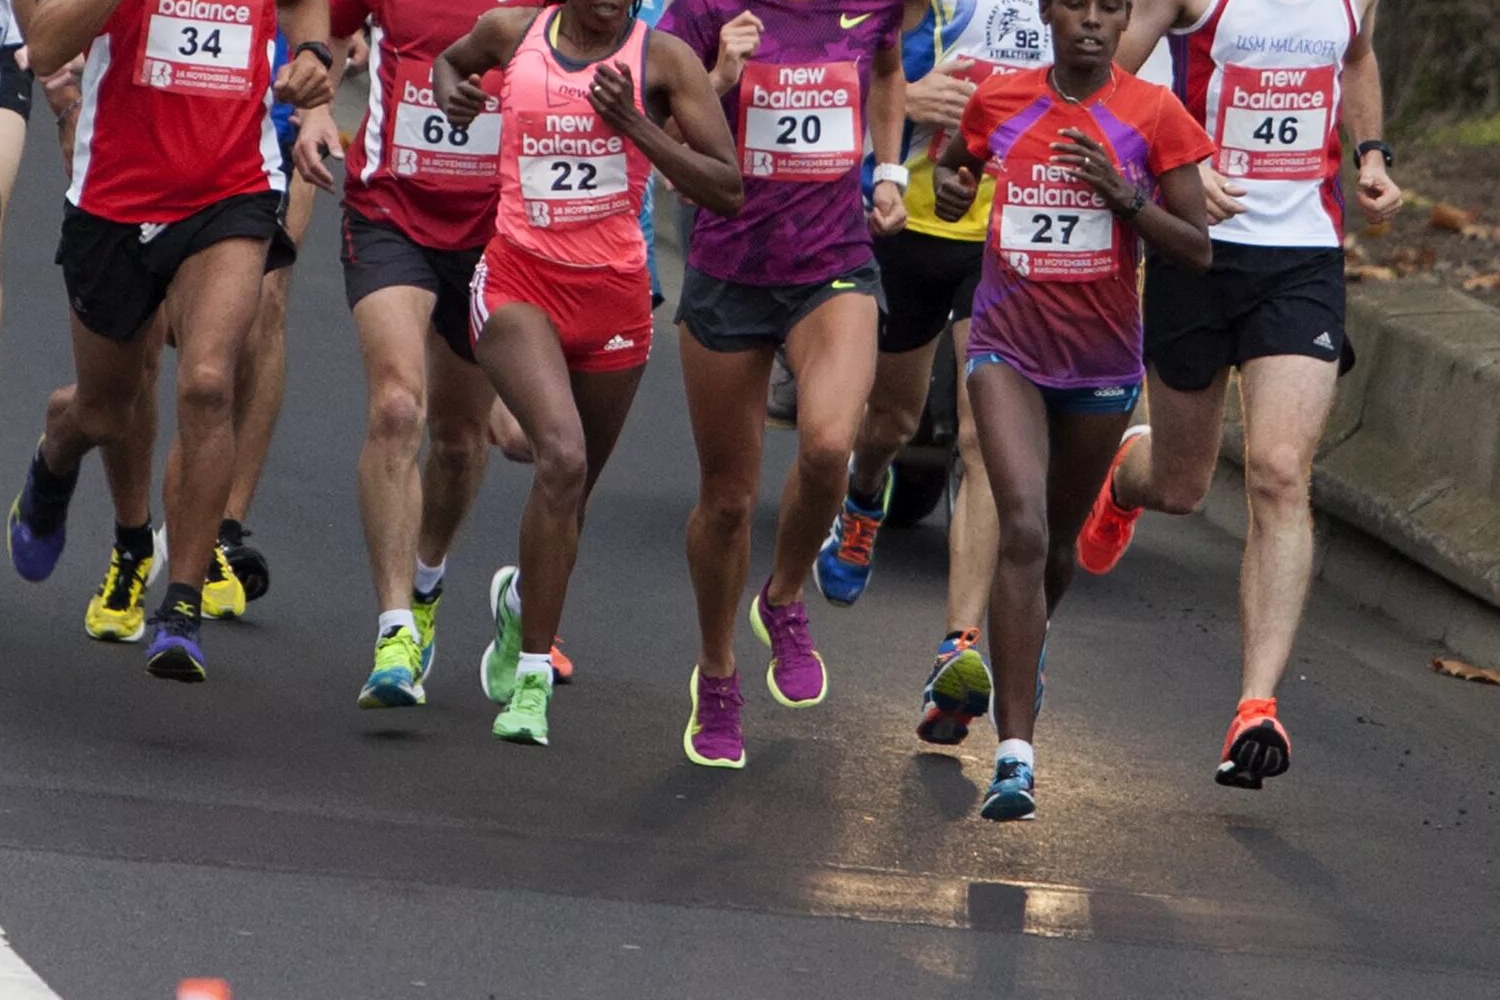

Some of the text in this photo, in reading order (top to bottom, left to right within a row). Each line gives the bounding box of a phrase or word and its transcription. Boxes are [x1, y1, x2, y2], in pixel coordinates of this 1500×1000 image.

[178, 26, 222, 59] 34
[1015, 30, 1039, 49] 92
[1236, 35, 1266, 51] USM
[779, 67, 825, 85] new
[1260, 70, 1307, 87] new
[753, 85, 848, 108] balance
[1233, 86, 1324, 109] balance
[423, 115, 470, 146] 68
[546, 114, 594, 133] new
[776, 115, 822, 145] 20
[1253, 117, 1298, 145] 46
[523, 135, 622, 155] balance
[551, 162, 598, 191] 22
[1008, 182, 1106, 207] balance
[1031, 214, 1080, 244] 27
